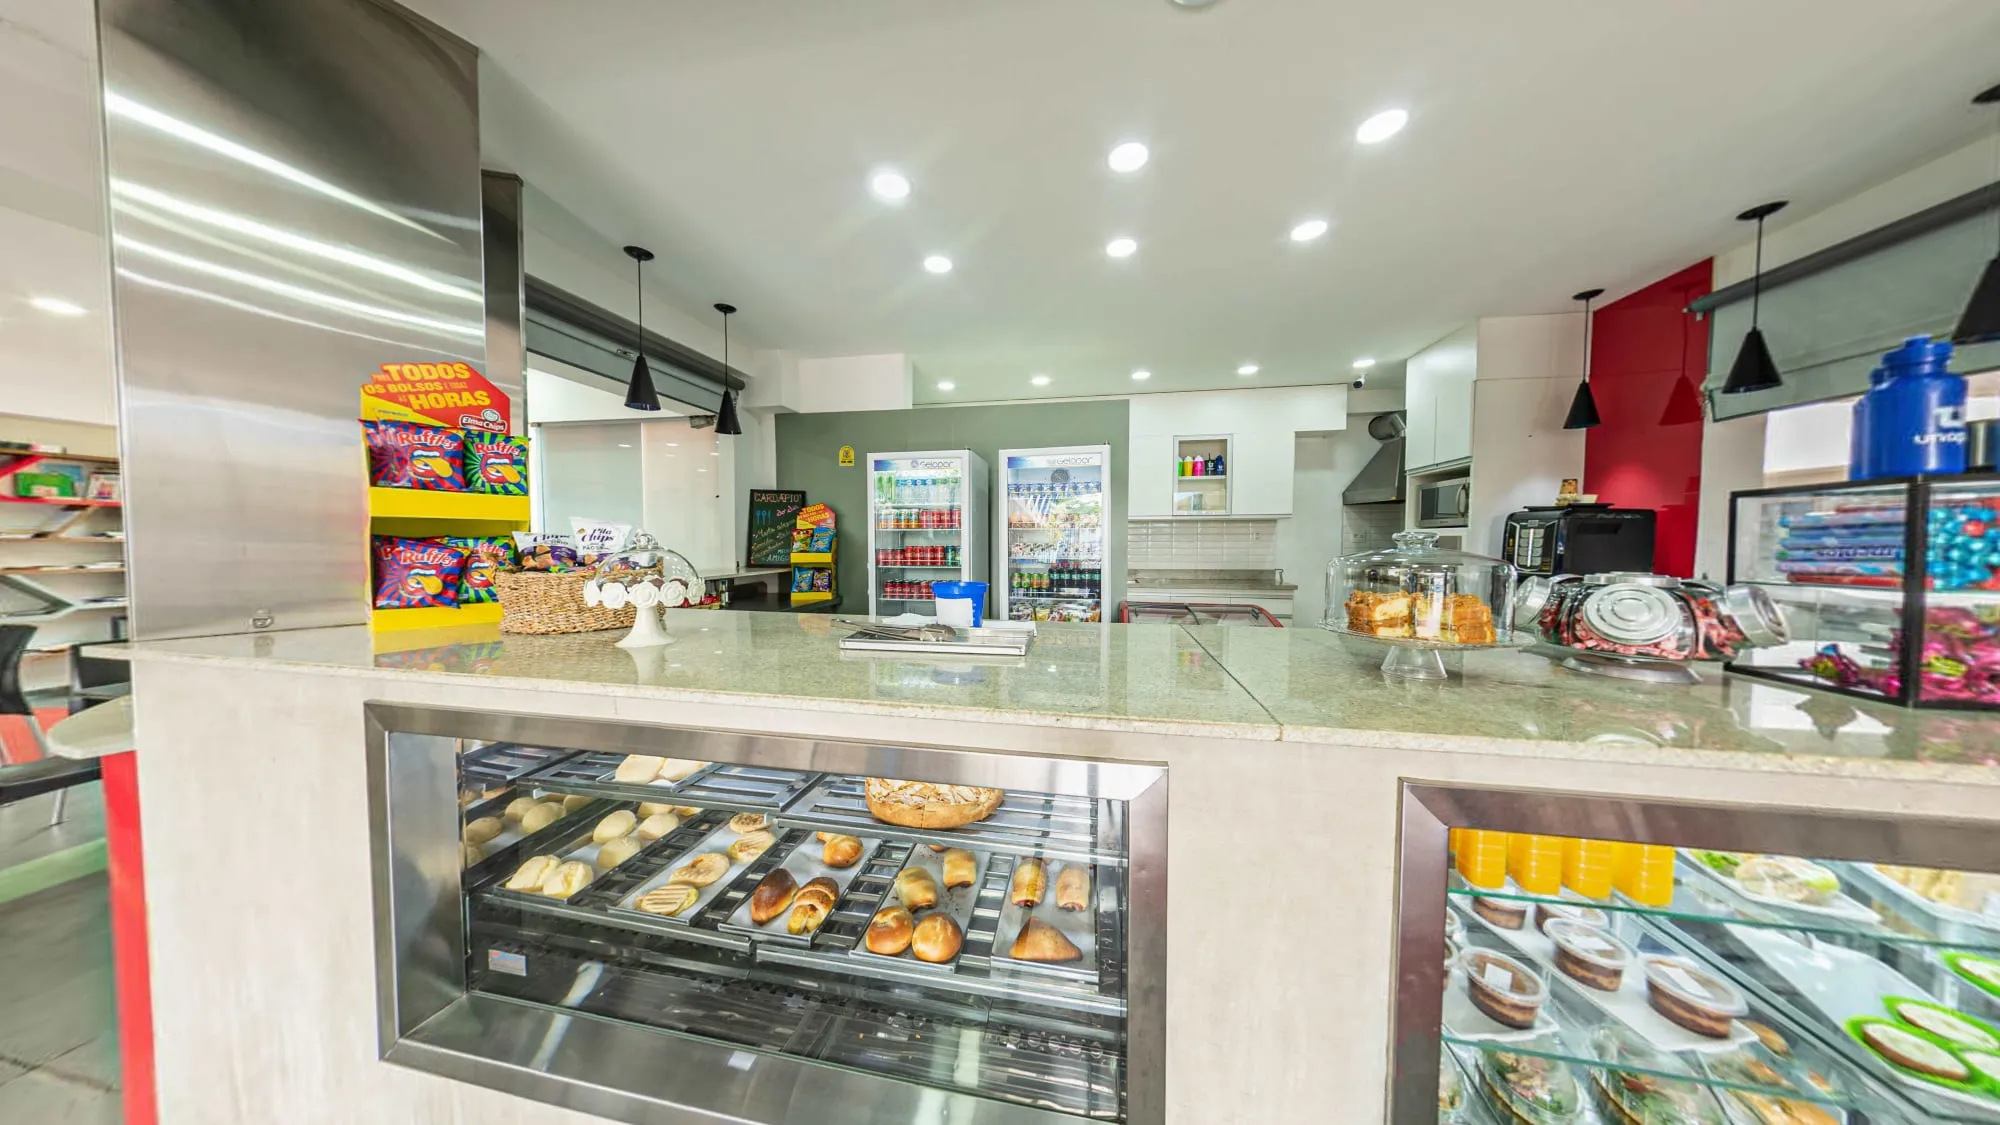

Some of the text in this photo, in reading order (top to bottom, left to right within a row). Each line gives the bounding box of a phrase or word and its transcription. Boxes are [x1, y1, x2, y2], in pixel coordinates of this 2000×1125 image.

[383, 362, 471, 381] TODOS
[364, 384, 386, 394] OS
[388, 382, 444, 392] BOLSOS
[409, 390, 491, 410] HORAS
[396, 428, 457, 450] Ruffles
[401, 549, 457, 567] Ruffles
